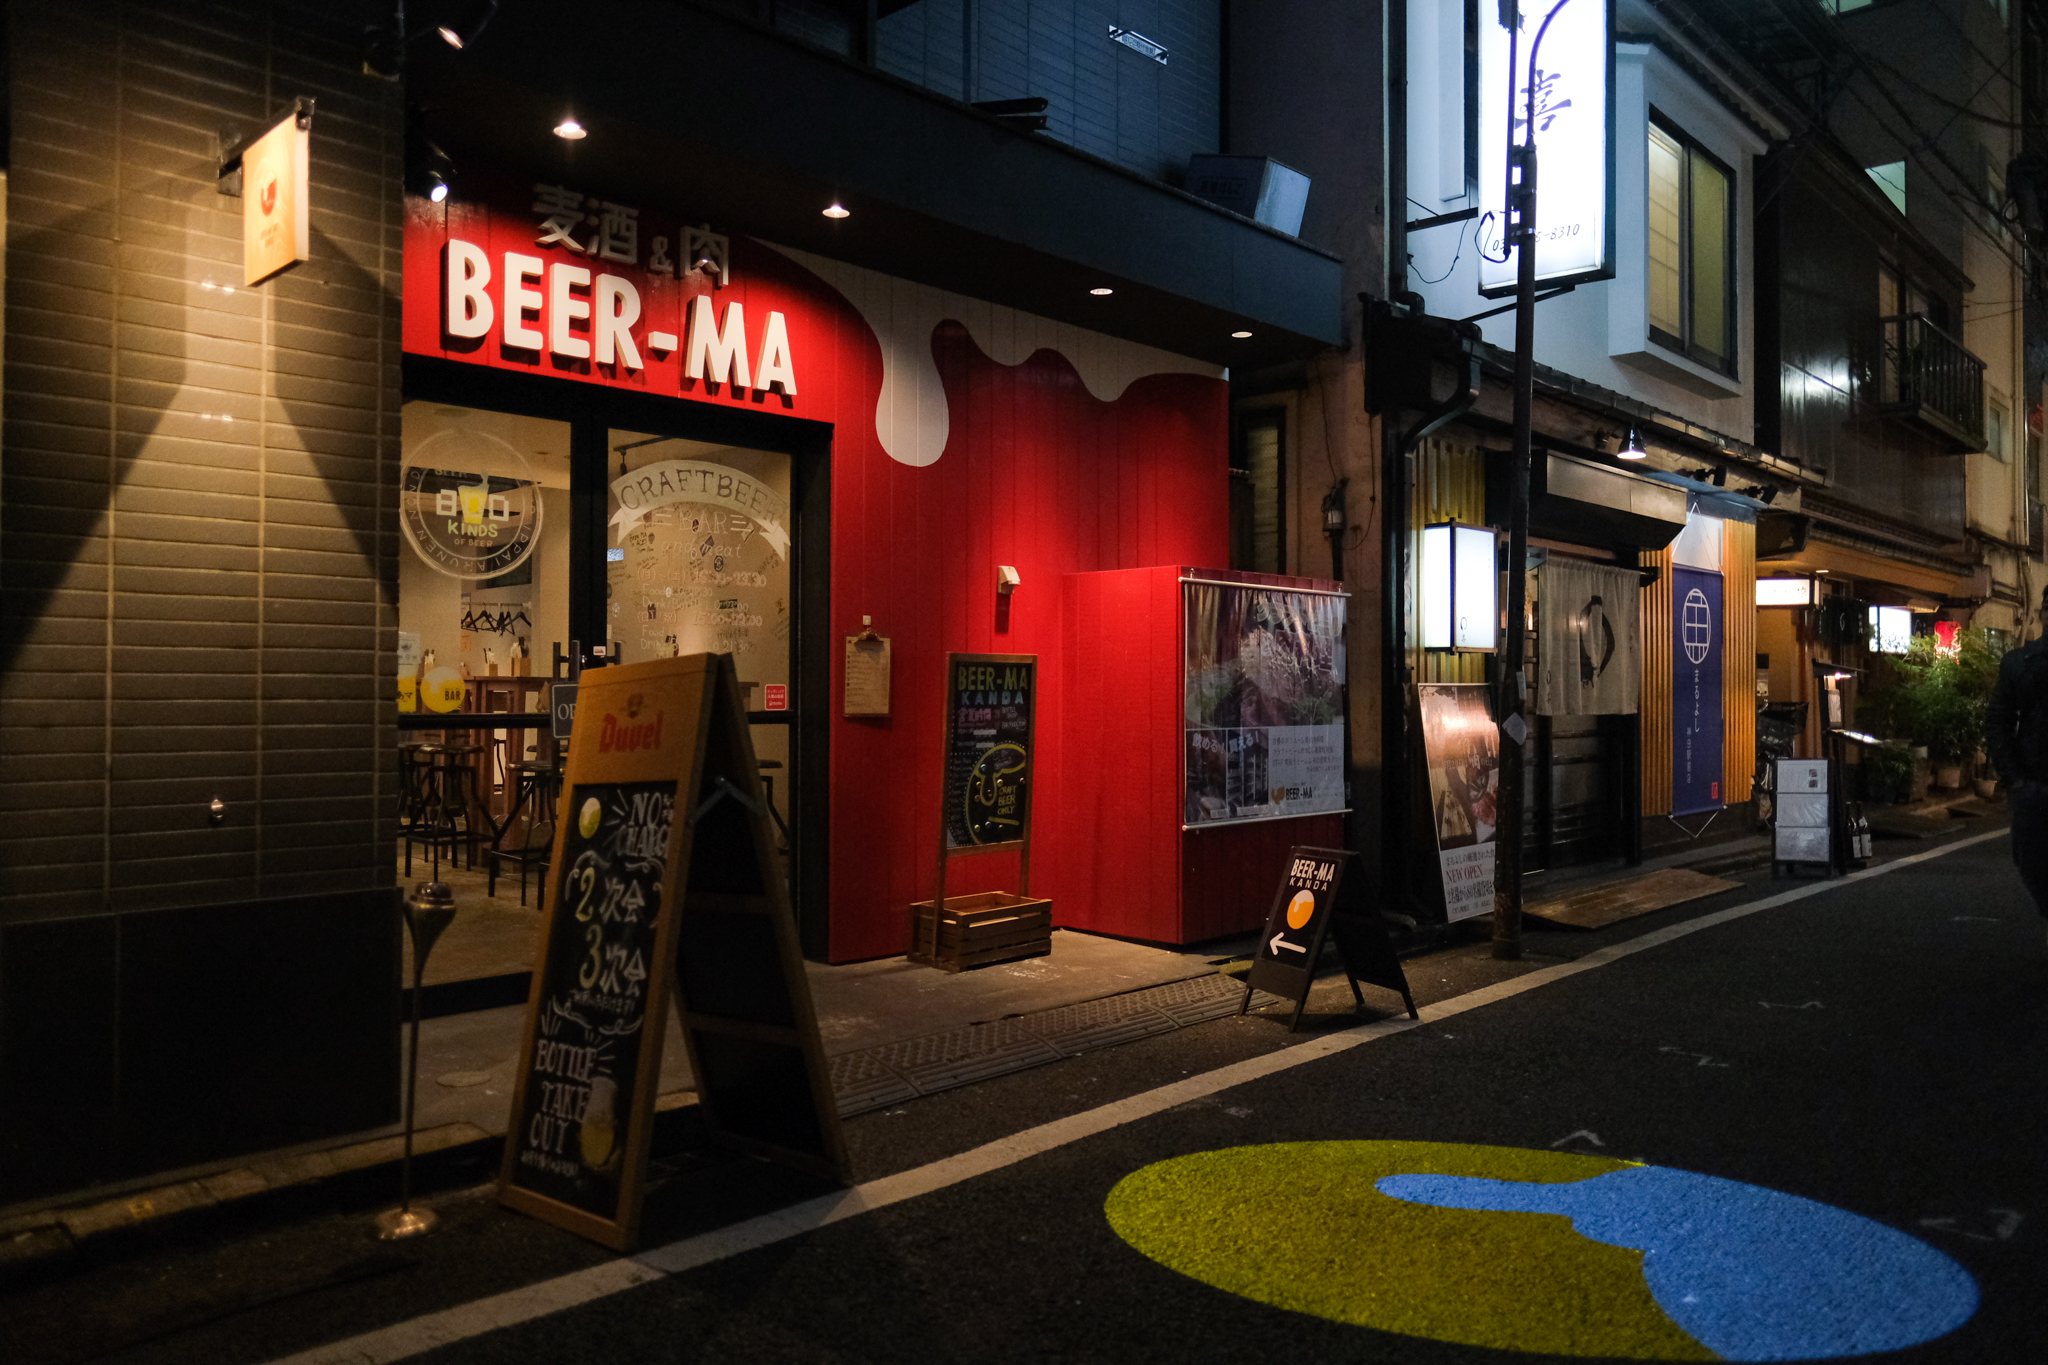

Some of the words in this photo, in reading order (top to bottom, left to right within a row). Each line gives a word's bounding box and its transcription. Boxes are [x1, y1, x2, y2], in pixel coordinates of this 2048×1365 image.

[533, 183, 639, 264] 麦酒
[650, 236, 673, 272] &
[679, 223, 730, 288] 肉
[446, 238, 798, 397] BEER-MA
[448, 519, 498, 538] KINDS
[679, 509, 728, 535] BAR
[454, 538, 465, 546] OF
[468, 538, 493, 548] BEER
[958, 666, 1028, 691] BEER-MA
[444, 690, 461, 701] BAR
[961, 691, 1024, 705] KANDA
[599, 710, 664, 754] Duvel
[998, 785, 1017, 795] CRAFT
[1285, 786, 1313, 801] BEER-MA
[628, 792, 662, 827] NO
[997, 795, 1016, 806] BEER
[997, 805, 1015, 815] ONLY
[1290, 858, 1336, 882] BEER-MA
[1446, 867, 1463, 884] NEW
[1464, 863, 1484, 882] OPEN
[1289, 877, 1328, 891] KANDA
[541, 1081, 592, 1124] TAKE
